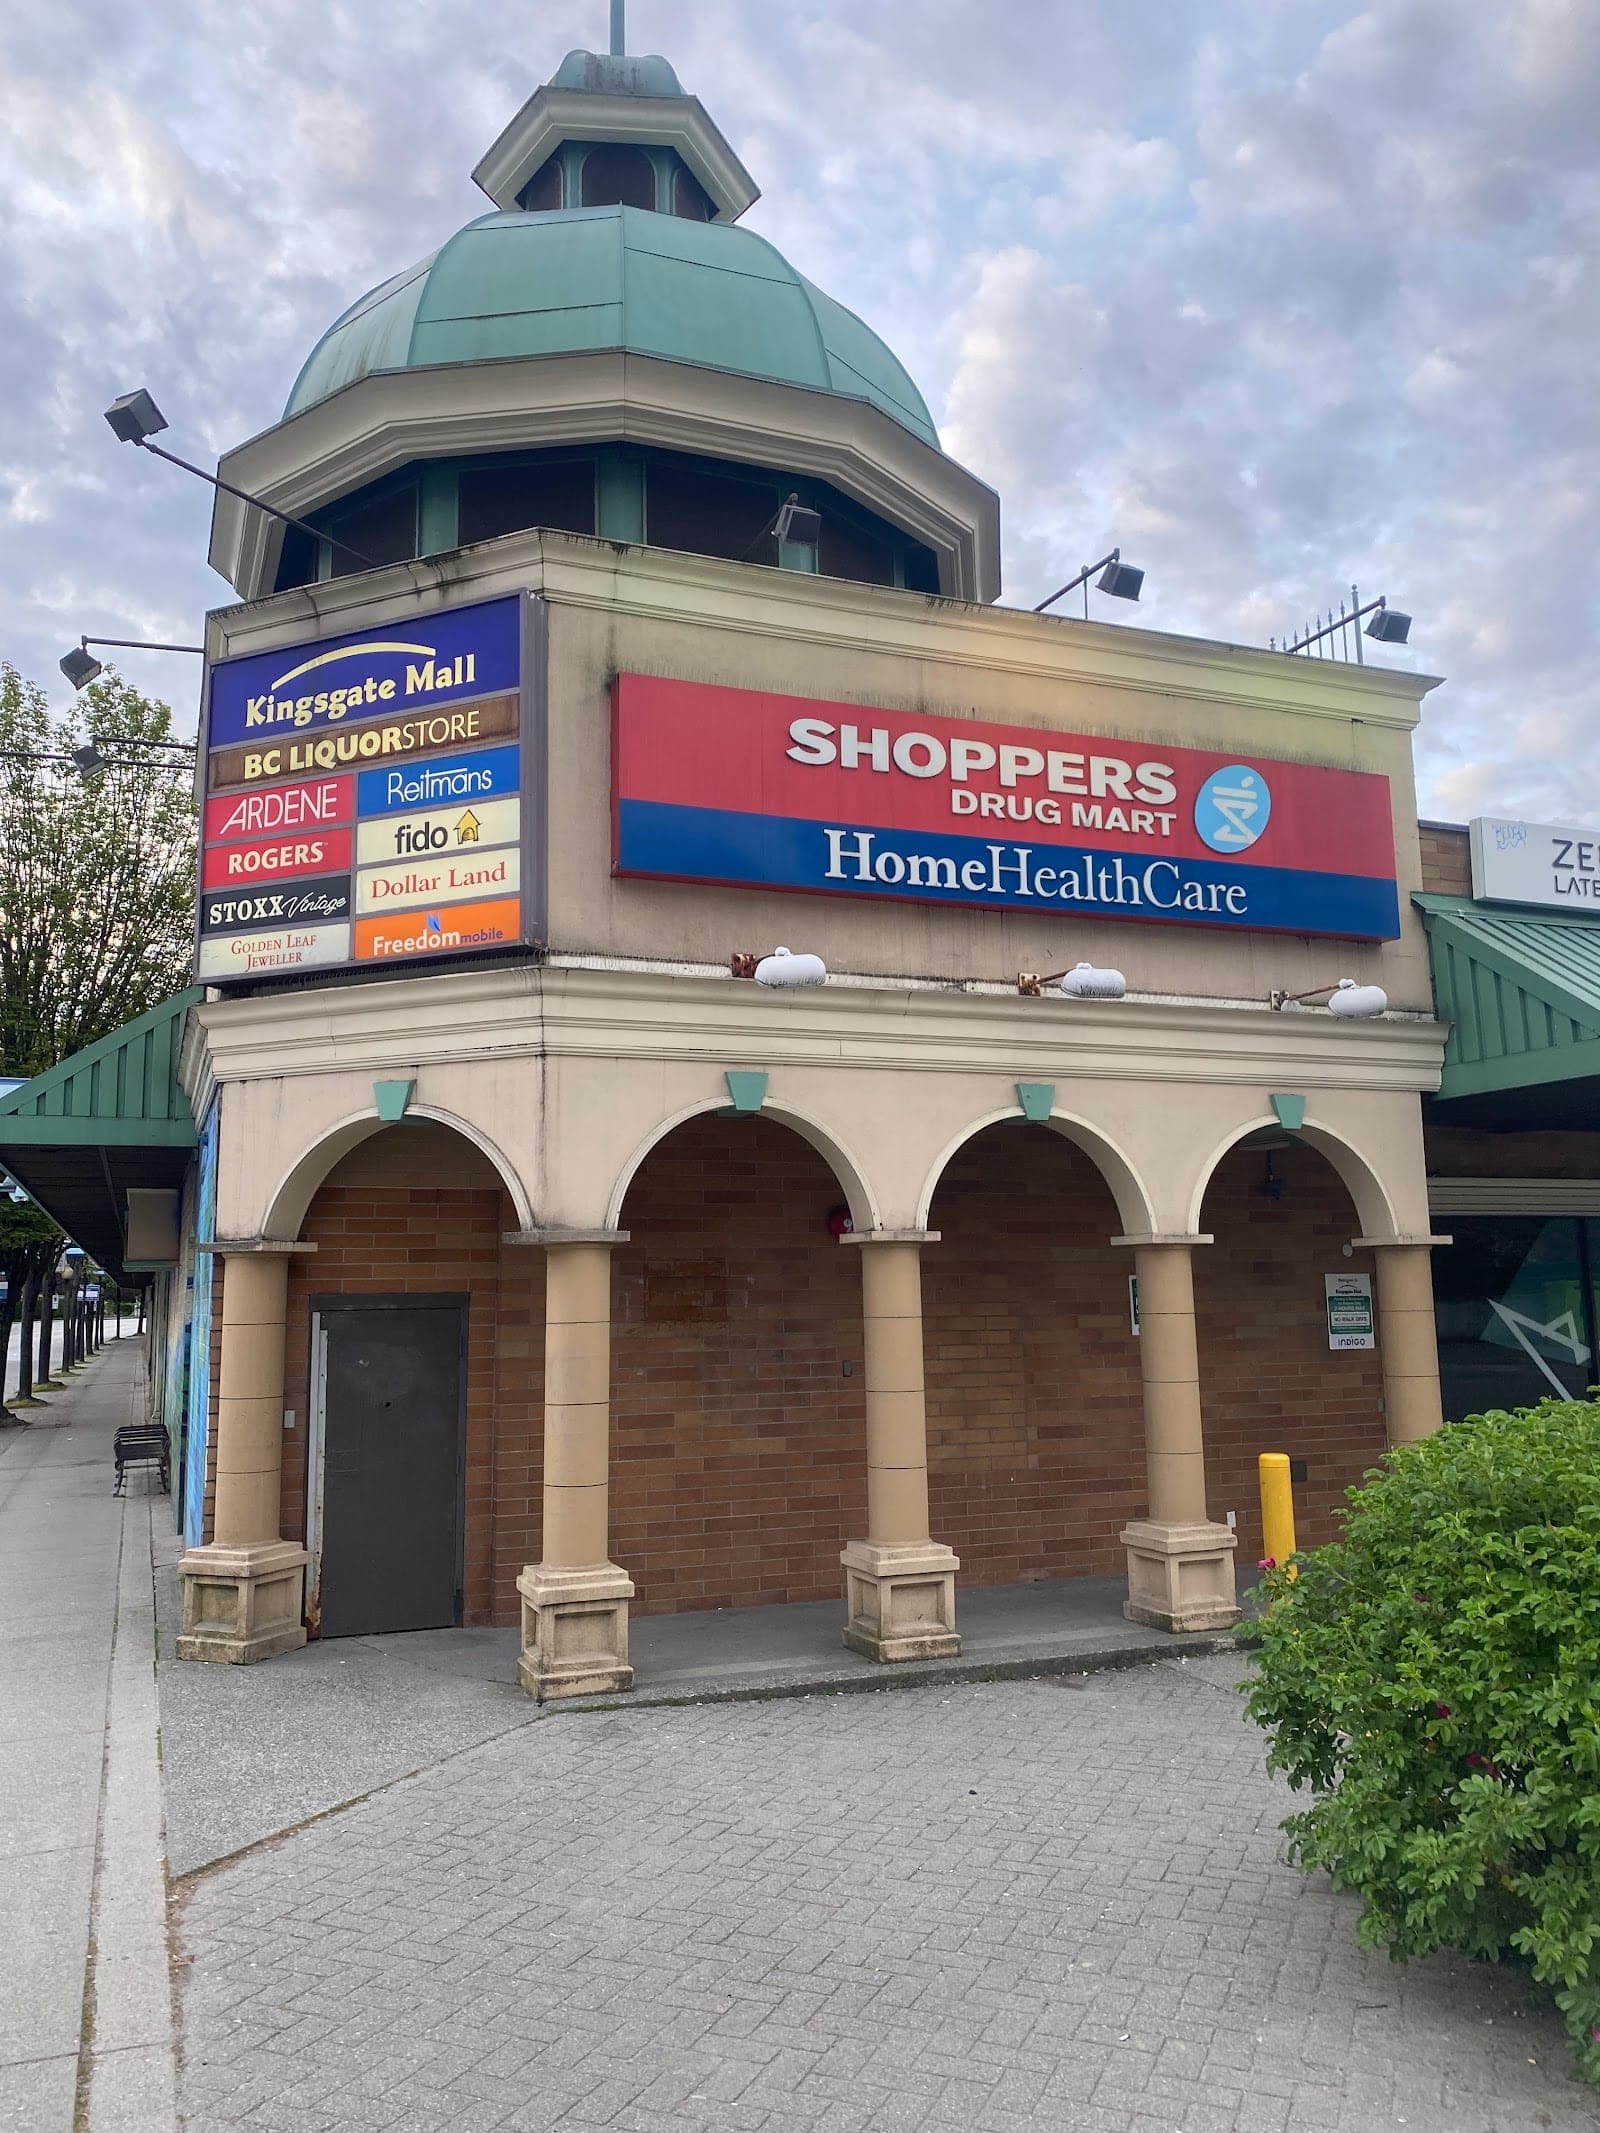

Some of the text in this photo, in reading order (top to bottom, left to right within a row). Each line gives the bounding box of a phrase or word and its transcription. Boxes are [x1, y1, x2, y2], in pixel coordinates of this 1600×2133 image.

[245, 654, 476, 727] Kingsgate Mall
[244, 750, 281, 779] BC
[786, 718, 1177, 804] SHOPPERS
[387, 767, 493, 805] Reitmans
[219, 783, 337, 835] ARDENE
[951, 788, 1177, 837] DRUG MART
[394, 821, 448, 854] fido
[228, 842, 324, 874] ROGERS
[823, 828, 1248, 915] HomeHealthCare
[1552, 839, 1600, 872] ZE
[371, 861, 506, 898] Dollar Land
[209, 893, 347, 925] STOXX Vintage
[231, 935, 317, 955] GOLDEN LEAF
[373, 927, 504, 956] Freedom mobile
[246, 951, 303, 972] JEWELLER
